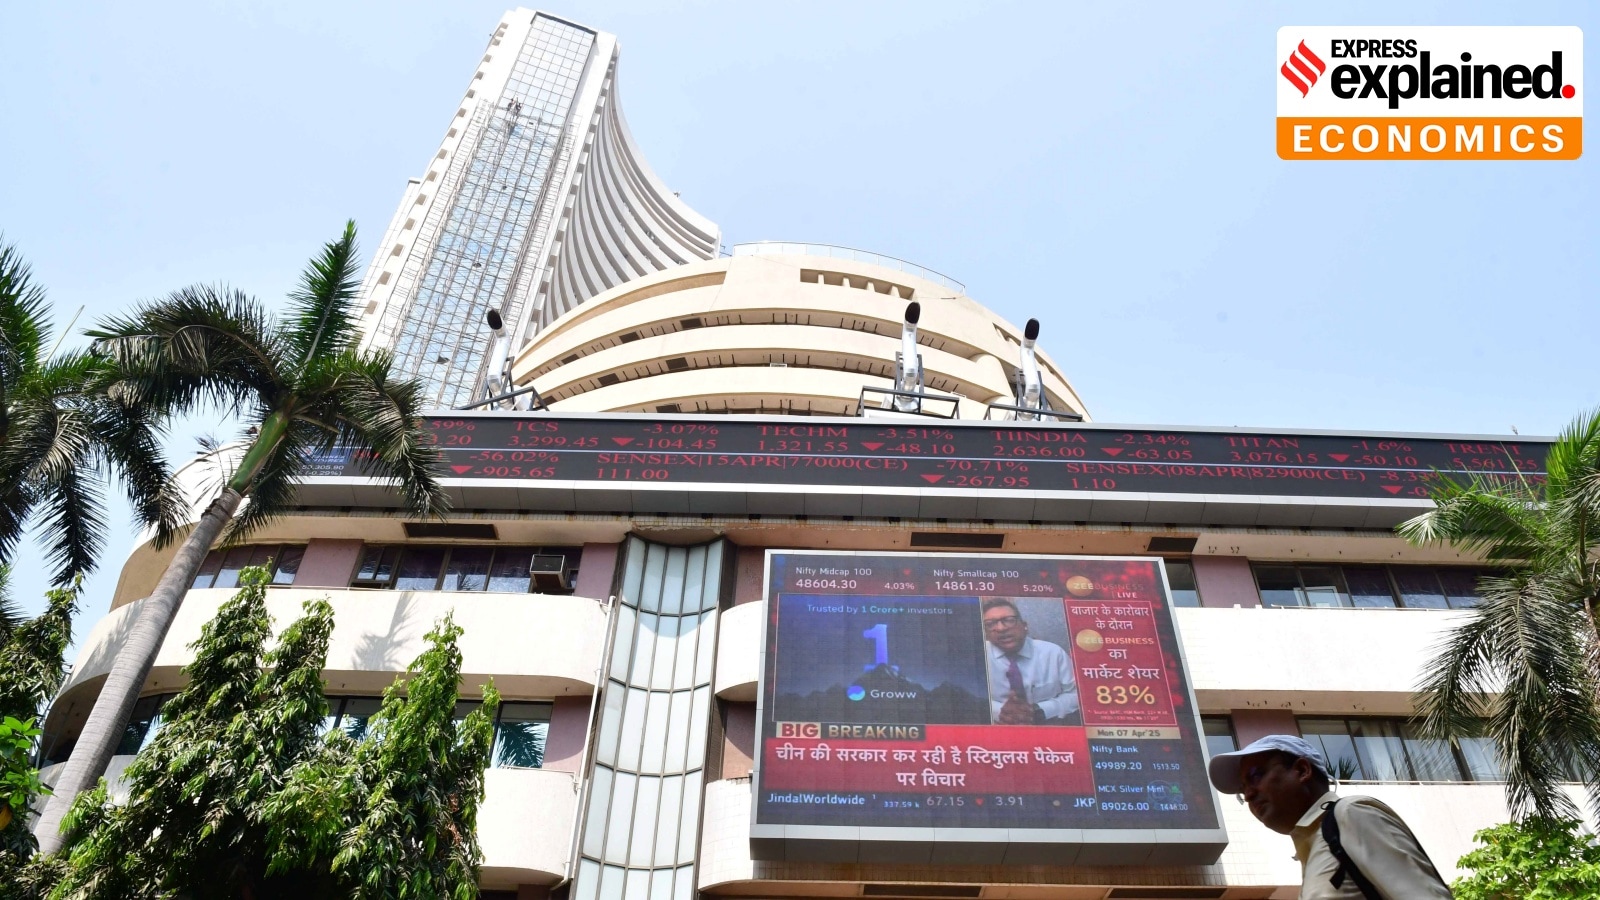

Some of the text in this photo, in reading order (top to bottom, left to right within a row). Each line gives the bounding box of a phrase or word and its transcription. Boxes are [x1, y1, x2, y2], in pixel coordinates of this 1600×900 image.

[513, 421, 559, 432] TCS
[643, 425, 720, 436] -3.07%
[757, 426, 848, 437] TECHM
[877, 428, 954, 440] -3.51%
[992, 430, 1087, 443] TIINDIA
[1114, 433, 1190, 446] -2.34%
[636, 439, 717, 449] -104.45
[1225, 436, 1300, 449] TITAN
[1352, 441, 1412, 452] -1.6%
[886, 443, 955, 454] -48.10
[1443, 443, 1520, 455] TRENT
[470, 451, 559, 463] -56.02%
[1127, 449, 1193, 460] -63.05
[1354, 455, 1418, 466] -50.10
[1452, 457, 1538, 469] 5,56125
[474, 466, 556, 478] -905.65
[937, 461, 1028, 472] -70.71%
[597, 468, 669, 480] 111.00
[946, 475, 1030, 487] -267.95
[1071, 478, 1116, 489] 1.10
[796, 567, 872, 577] Nifty Midcap 100
[933, 569, 1019, 579] Nifty Smallcap 100
[796, 579, 857, 589] 48604.30
[884, 582, 915, 590] 4.03%
[935, 581, 995, 591] 14861.30
[1023, 584, 1053, 592] 5.20%
[807, 605, 844, 613] Trusted
[847, 605, 858, 614] by
[870, 605, 904, 613] Crore+
[907, 606, 953, 614] investors
[1070, 603, 1150, 616] बाजार के कारोबार
[1095, 617, 1133, 630] के दौरान
[1107, 648, 1127, 659] का
[1082, 664, 1160, 679] मार्केट शेयर
[870, 689, 917, 699] Groww
[1096, 685, 1155, 705] 83%
[781, 723, 819, 737] BIG
[829, 725, 919, 738] BREAKING
[776, 743, 1074, 767] चीन की सरकार कर रही है स्टिमुलस पैकेज
[1092, 745, 1138, 754] Nifty Bank
[1095, 762, 1142, 770] 49989.20
[896, 768, 966, 787] पर विचार
[1098, 785, 1116, 793] MCX
[1119, 785, 1143, 793] Silver
[767, 793, 865, 805] JindalWorldwide
[926, 796, 1024, 806] 67.15 3.91
[1102, 803, 1149, 811] 89026.00
